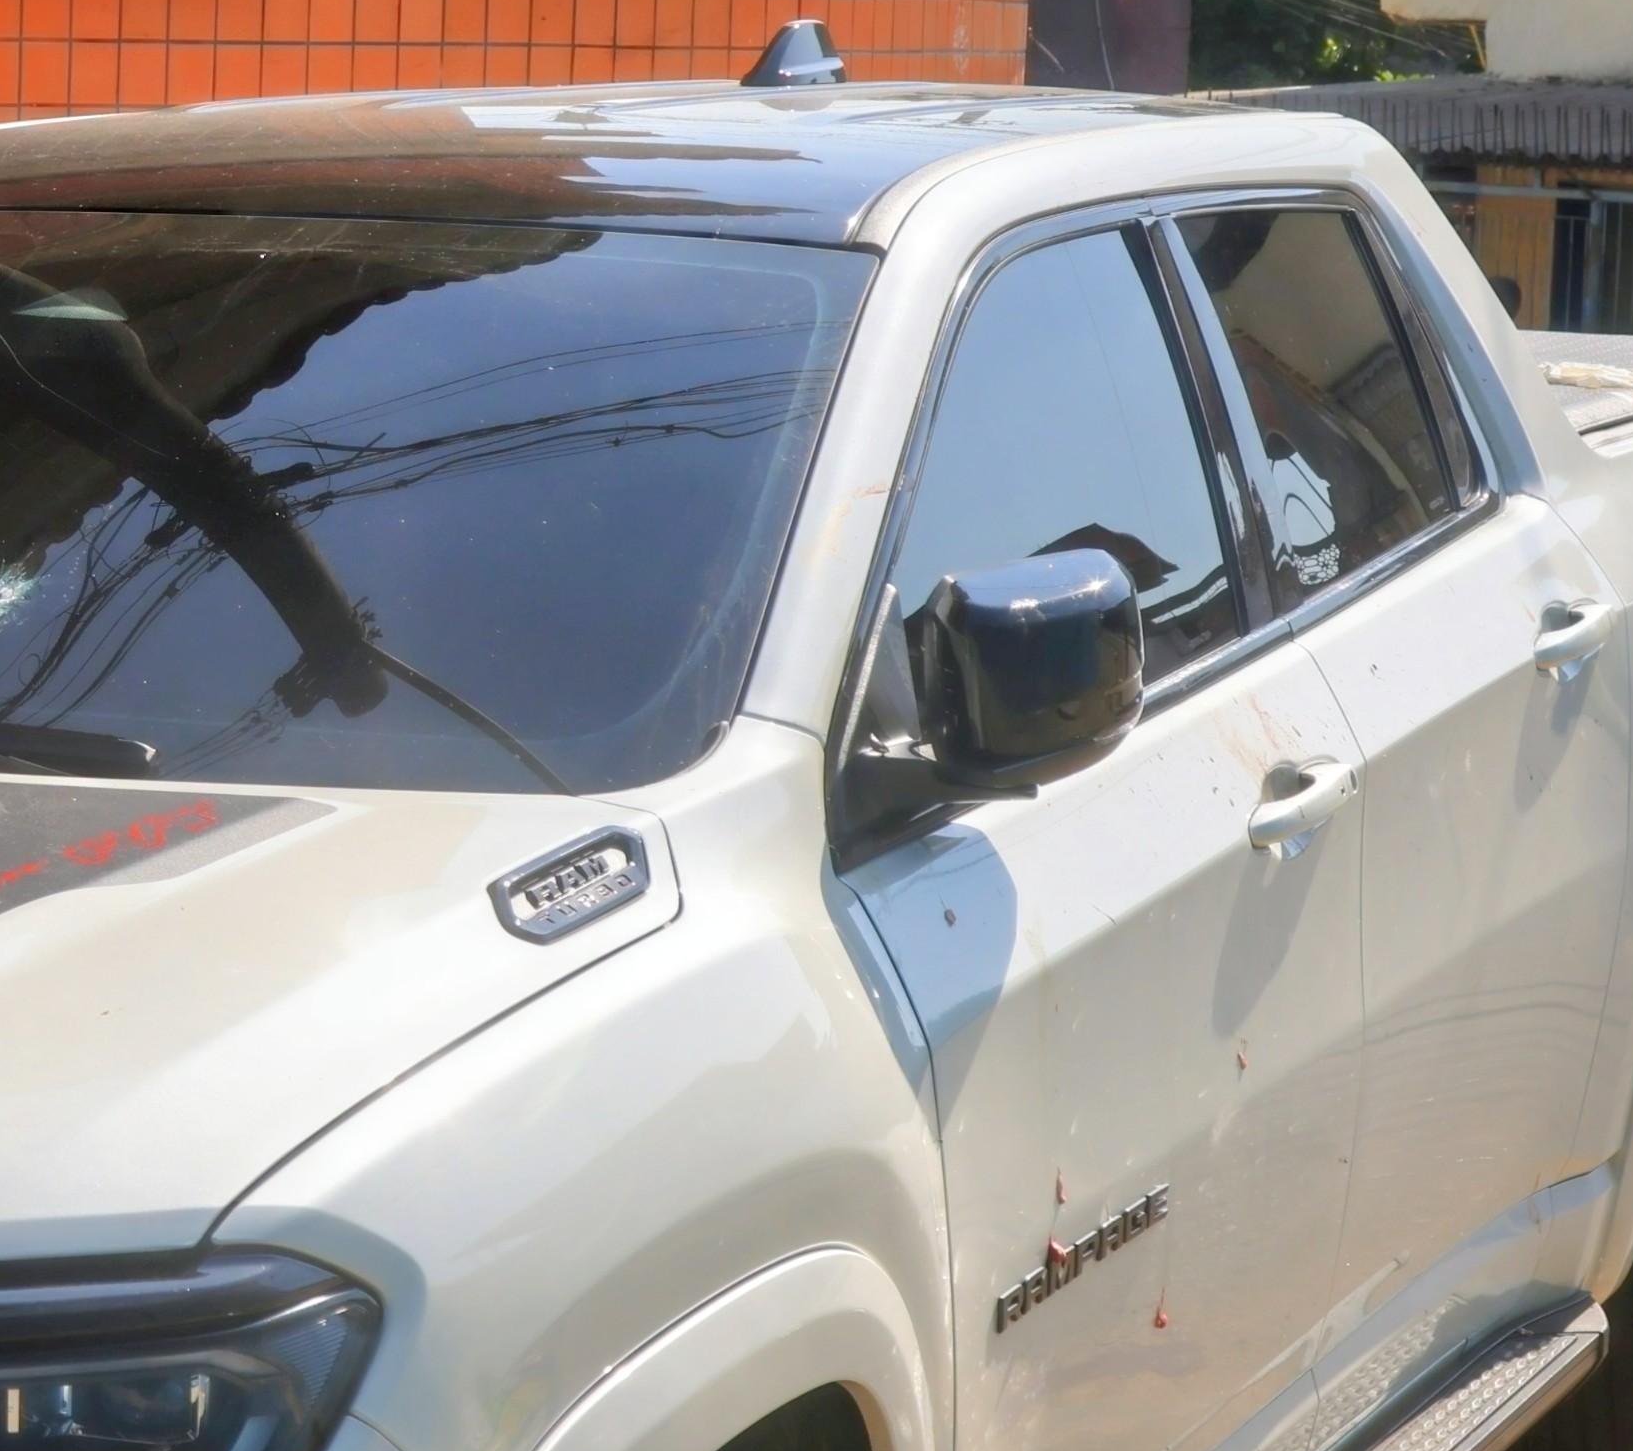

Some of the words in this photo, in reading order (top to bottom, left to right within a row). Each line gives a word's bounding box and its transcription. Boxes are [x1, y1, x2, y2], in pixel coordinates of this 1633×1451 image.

[524, 853, 610, 909] RAM
[538, 874, 634, 925] TURBO
[996, 1183, 1169, 1333] RAMPAGE
